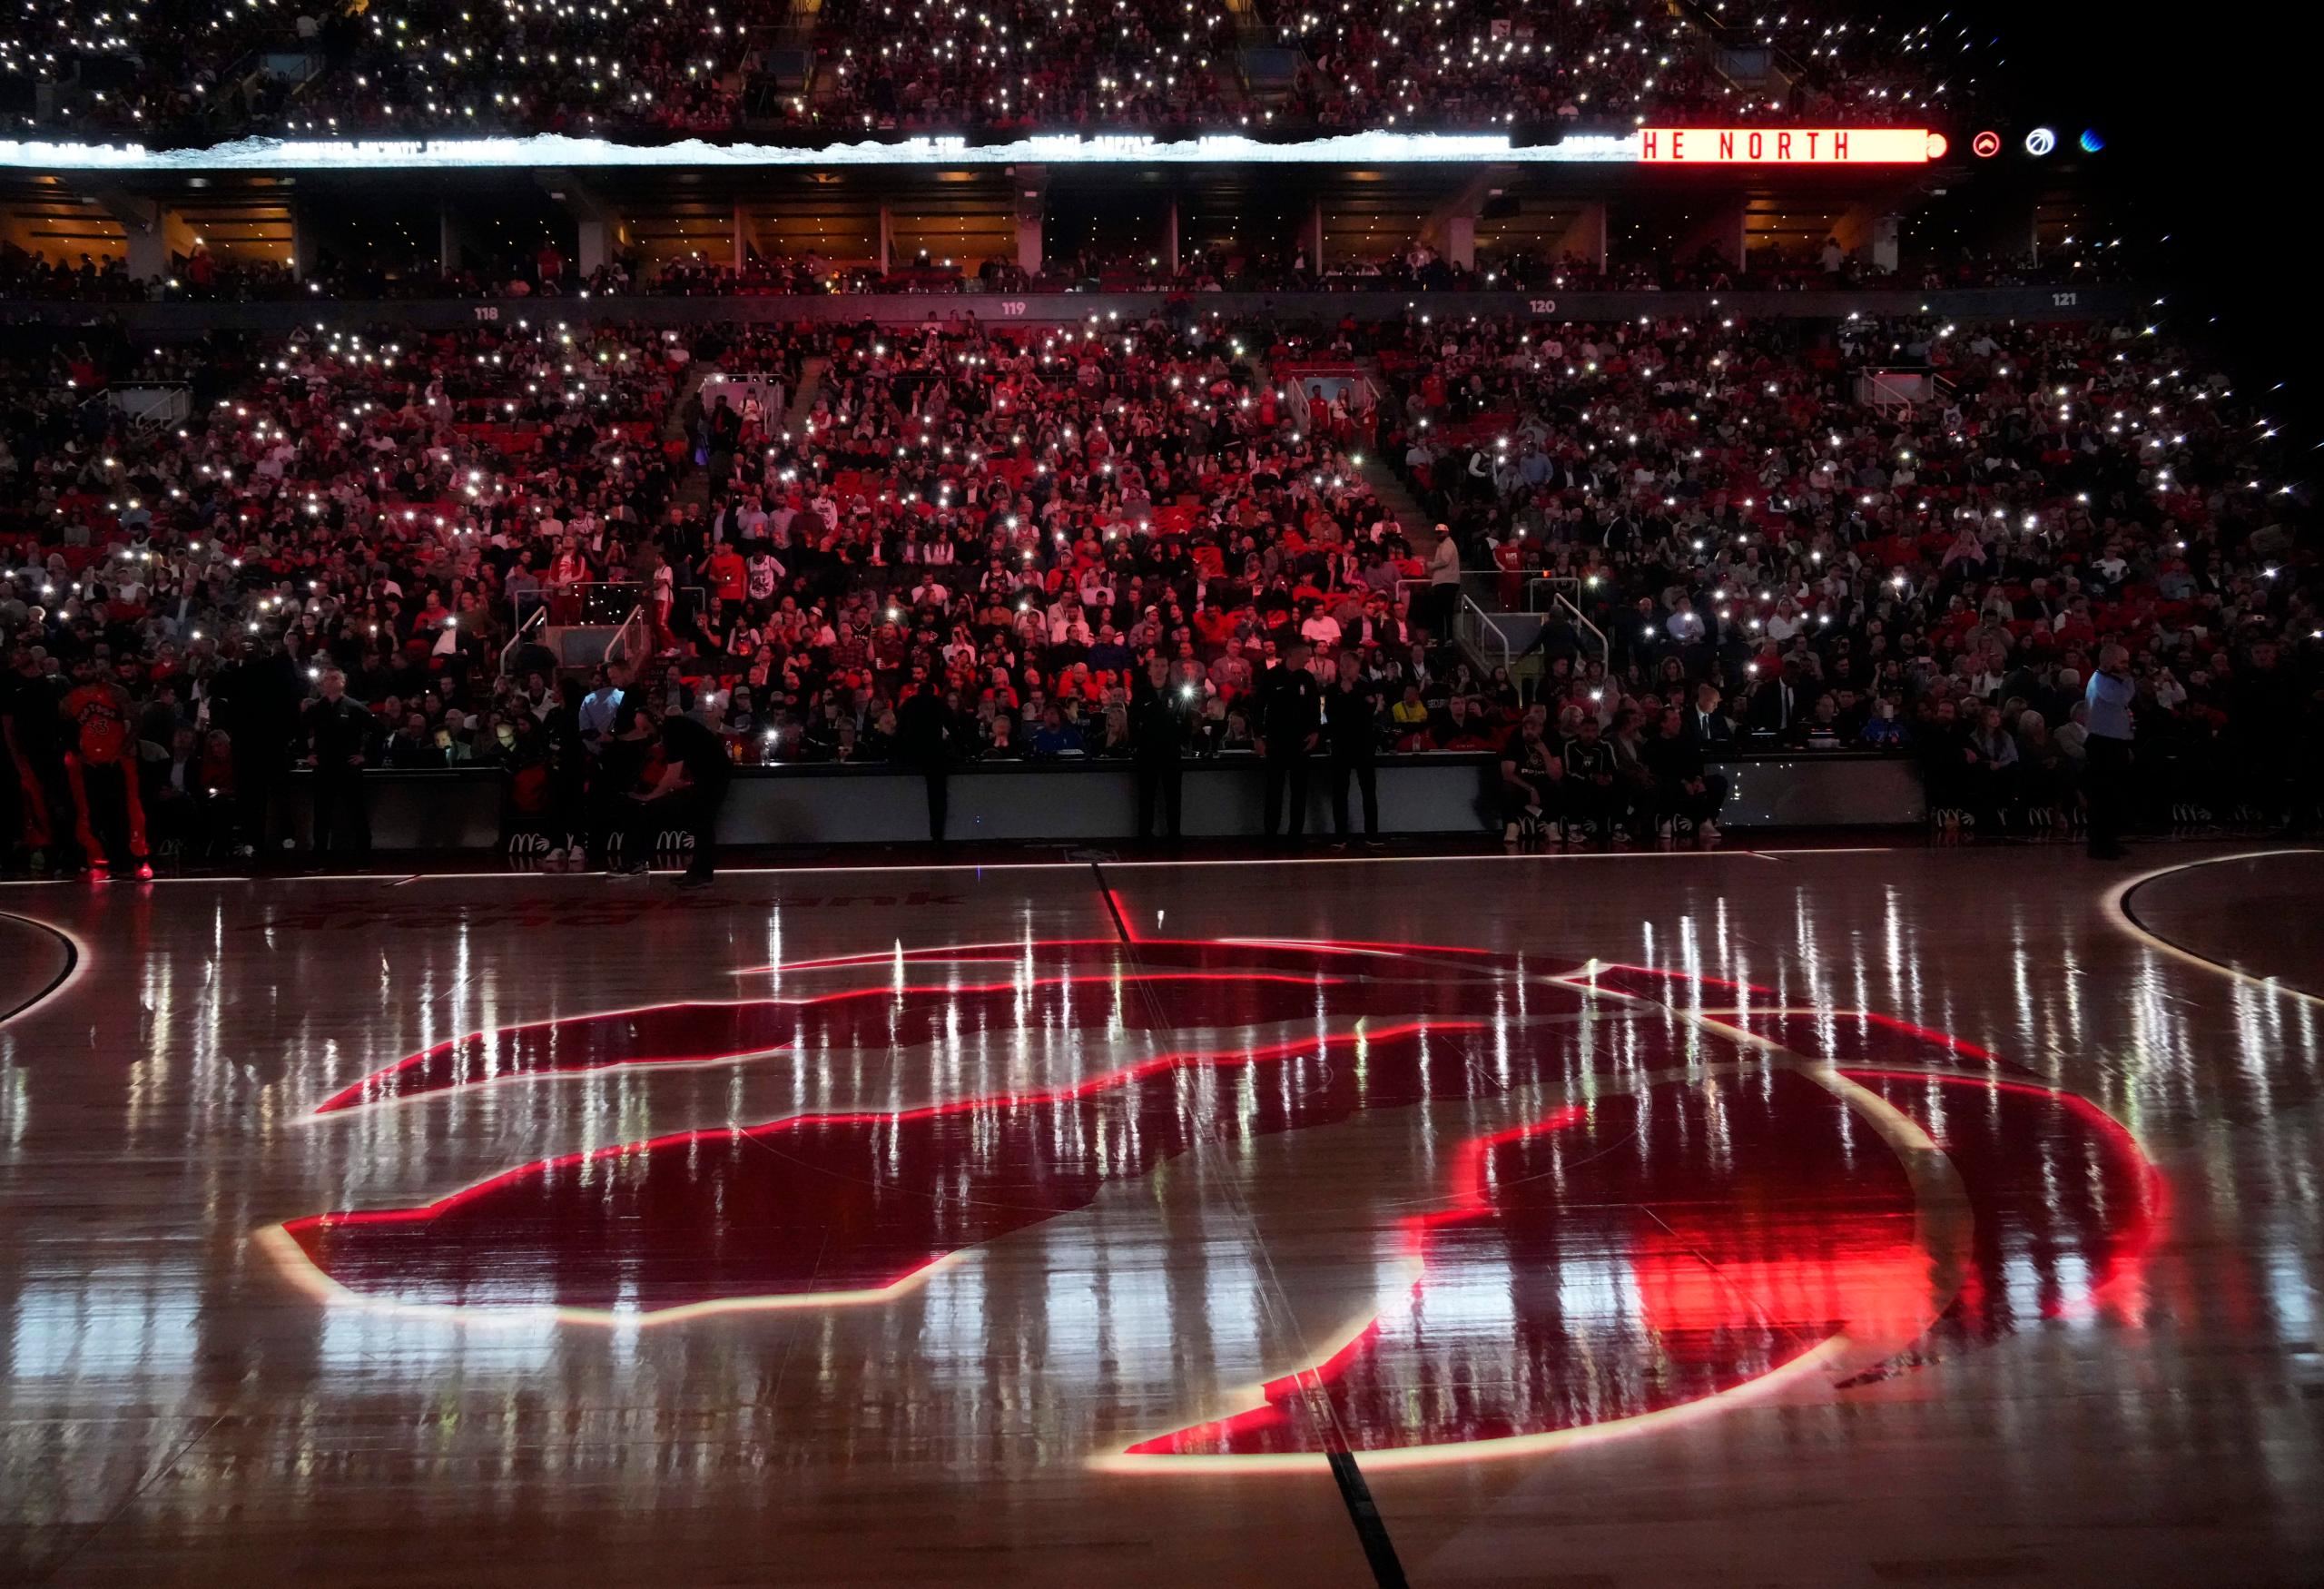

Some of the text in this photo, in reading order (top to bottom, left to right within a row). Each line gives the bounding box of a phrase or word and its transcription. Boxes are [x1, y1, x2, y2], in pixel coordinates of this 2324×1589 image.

[1719, 131, 1849, 161] NORTH
[1530, 300, 1556, 313] 120
[2052, 292, 2077, 307] 121
[474, 307, 498, 321] 118
[1001, 301, 1026, 315] 119
[87, 719, 109, 736] 33
